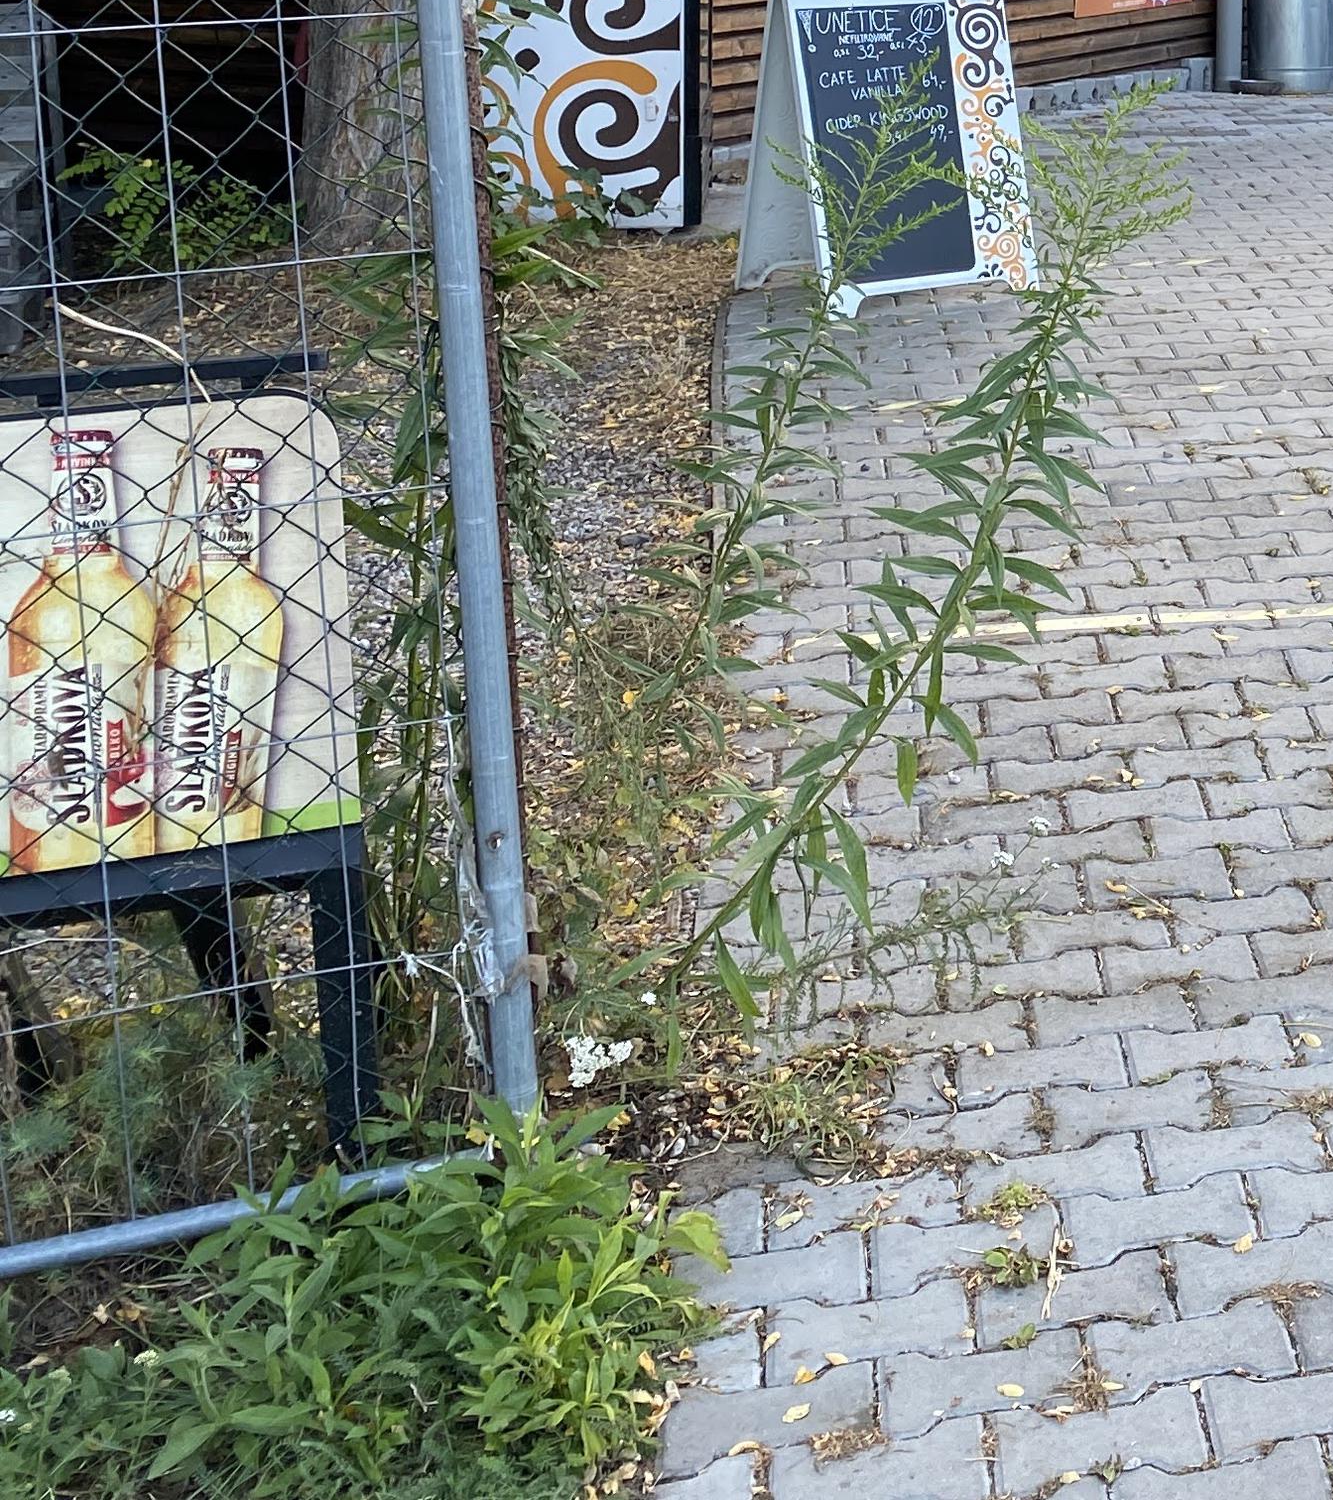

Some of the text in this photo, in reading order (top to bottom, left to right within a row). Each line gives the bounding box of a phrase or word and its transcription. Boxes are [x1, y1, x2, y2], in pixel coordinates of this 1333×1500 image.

[857, 45, 884, 61] 32,-
[819, 66, 908, 89] CAFE LATTE
[922, 73, 947, 90] 64,-
